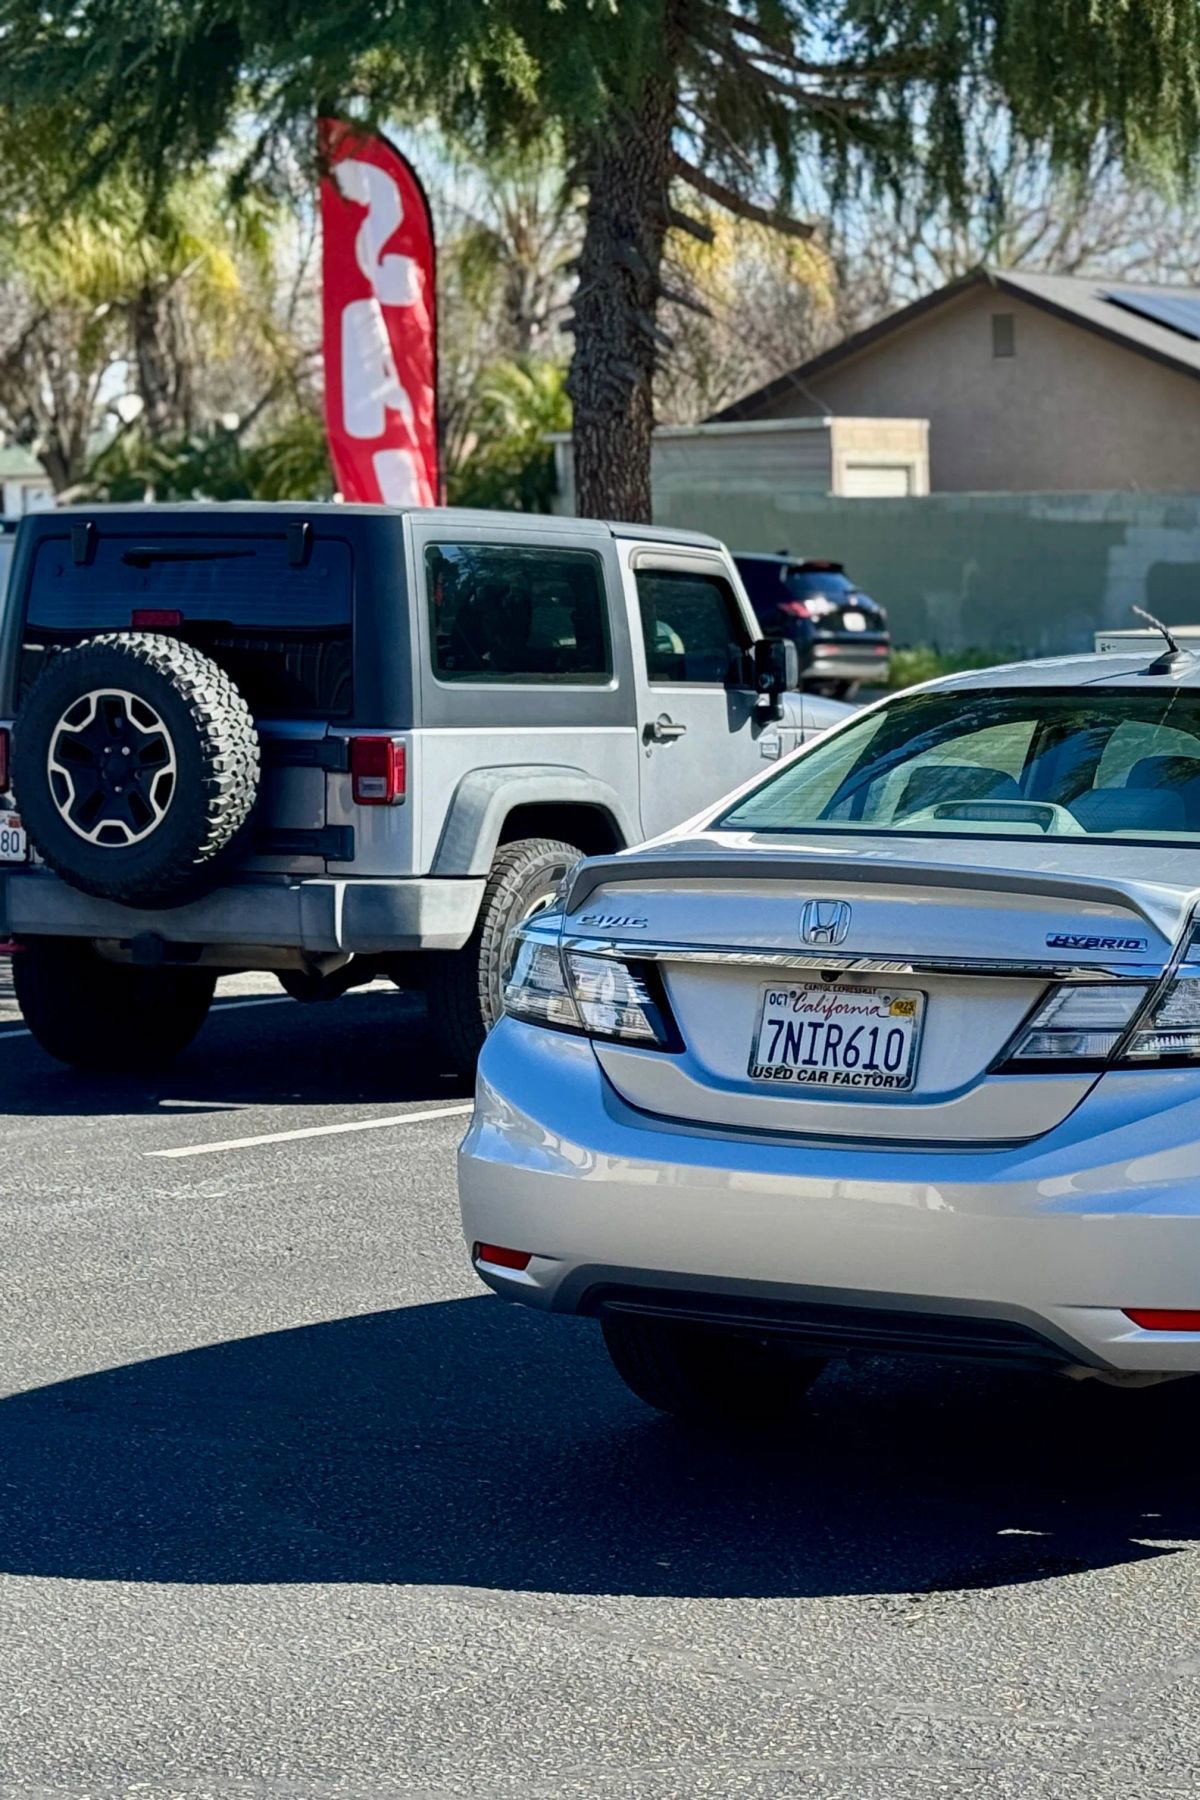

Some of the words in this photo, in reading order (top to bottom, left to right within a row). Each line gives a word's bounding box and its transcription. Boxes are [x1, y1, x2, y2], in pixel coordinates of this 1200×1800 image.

[576, 914, 649, 929] CIVIC
[1051, 935, 1142, 950] HYBRID
[769, 992, 788, 1006] OCT
[792, 991, 890, 1021] California
[766, 1019, 905, 1072] 7NIR610
[753, 1066, 794, 1080] USED
[797, 1069, 828, 1083] CAR
[832, 1071, 906, 1088] FACTORY
